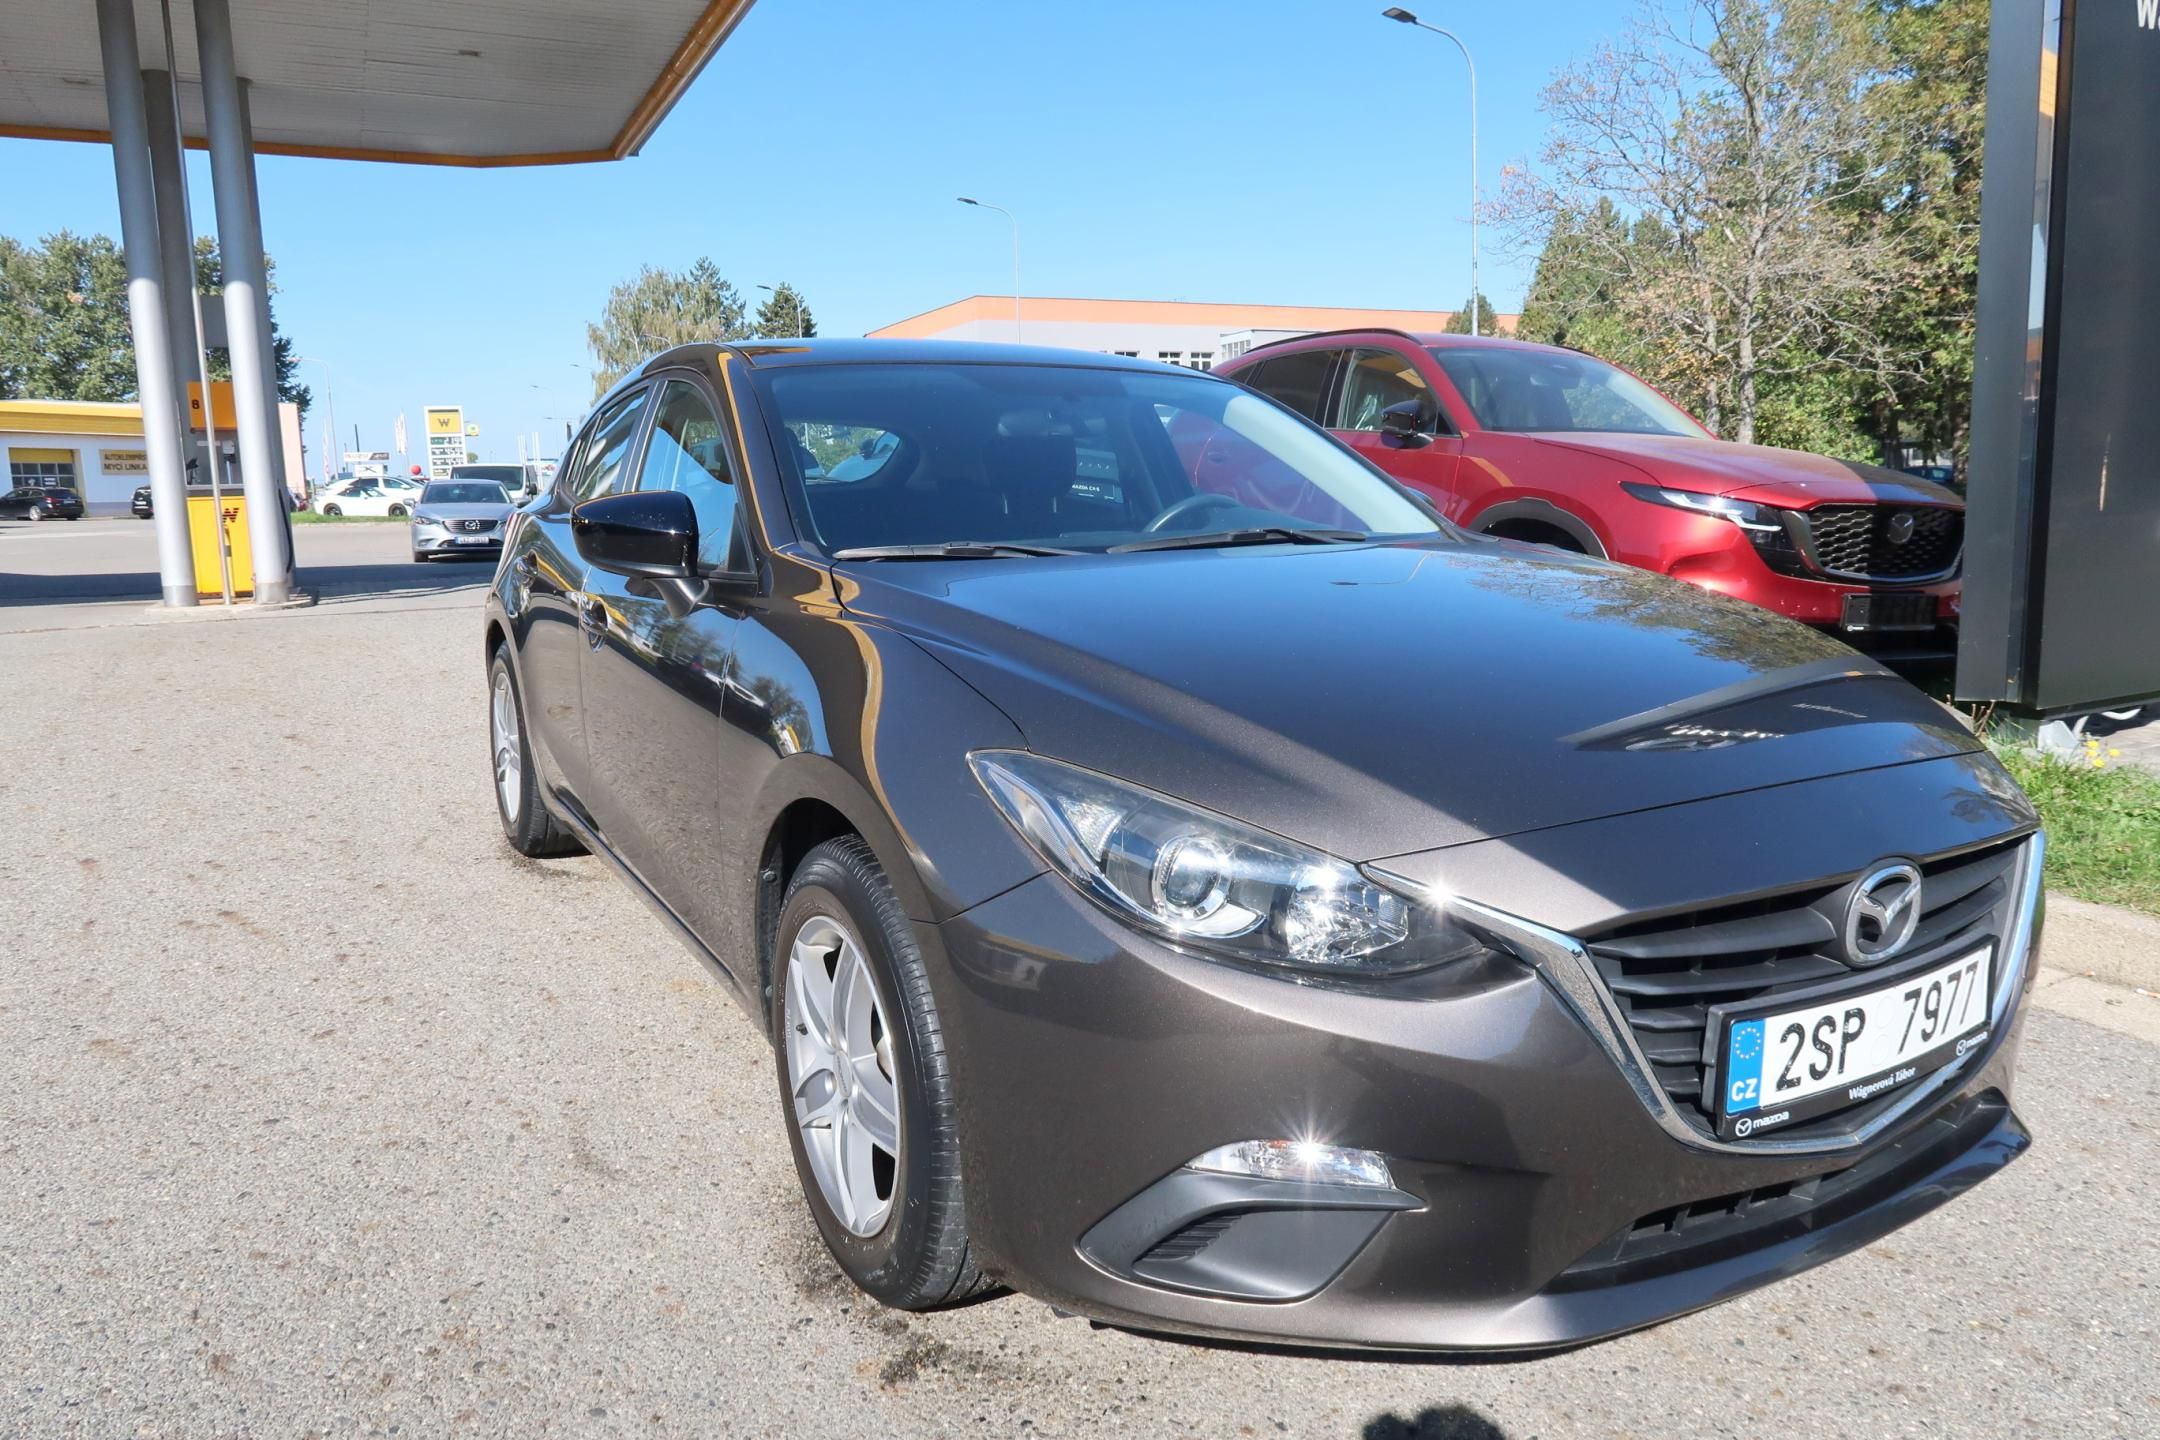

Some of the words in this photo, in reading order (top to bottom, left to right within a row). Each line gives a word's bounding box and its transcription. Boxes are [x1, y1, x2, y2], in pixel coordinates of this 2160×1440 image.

[191, 399, 200, 410] 8
[437, 418, 451, 428] W
[1776, 1007, 1866, 1092] 2SP
[1898, 960, 1979, 1055] 7977
[1896, 1067, 1917, 1082] Tábor
[1731, 1078, 1758, 1101] CZ
